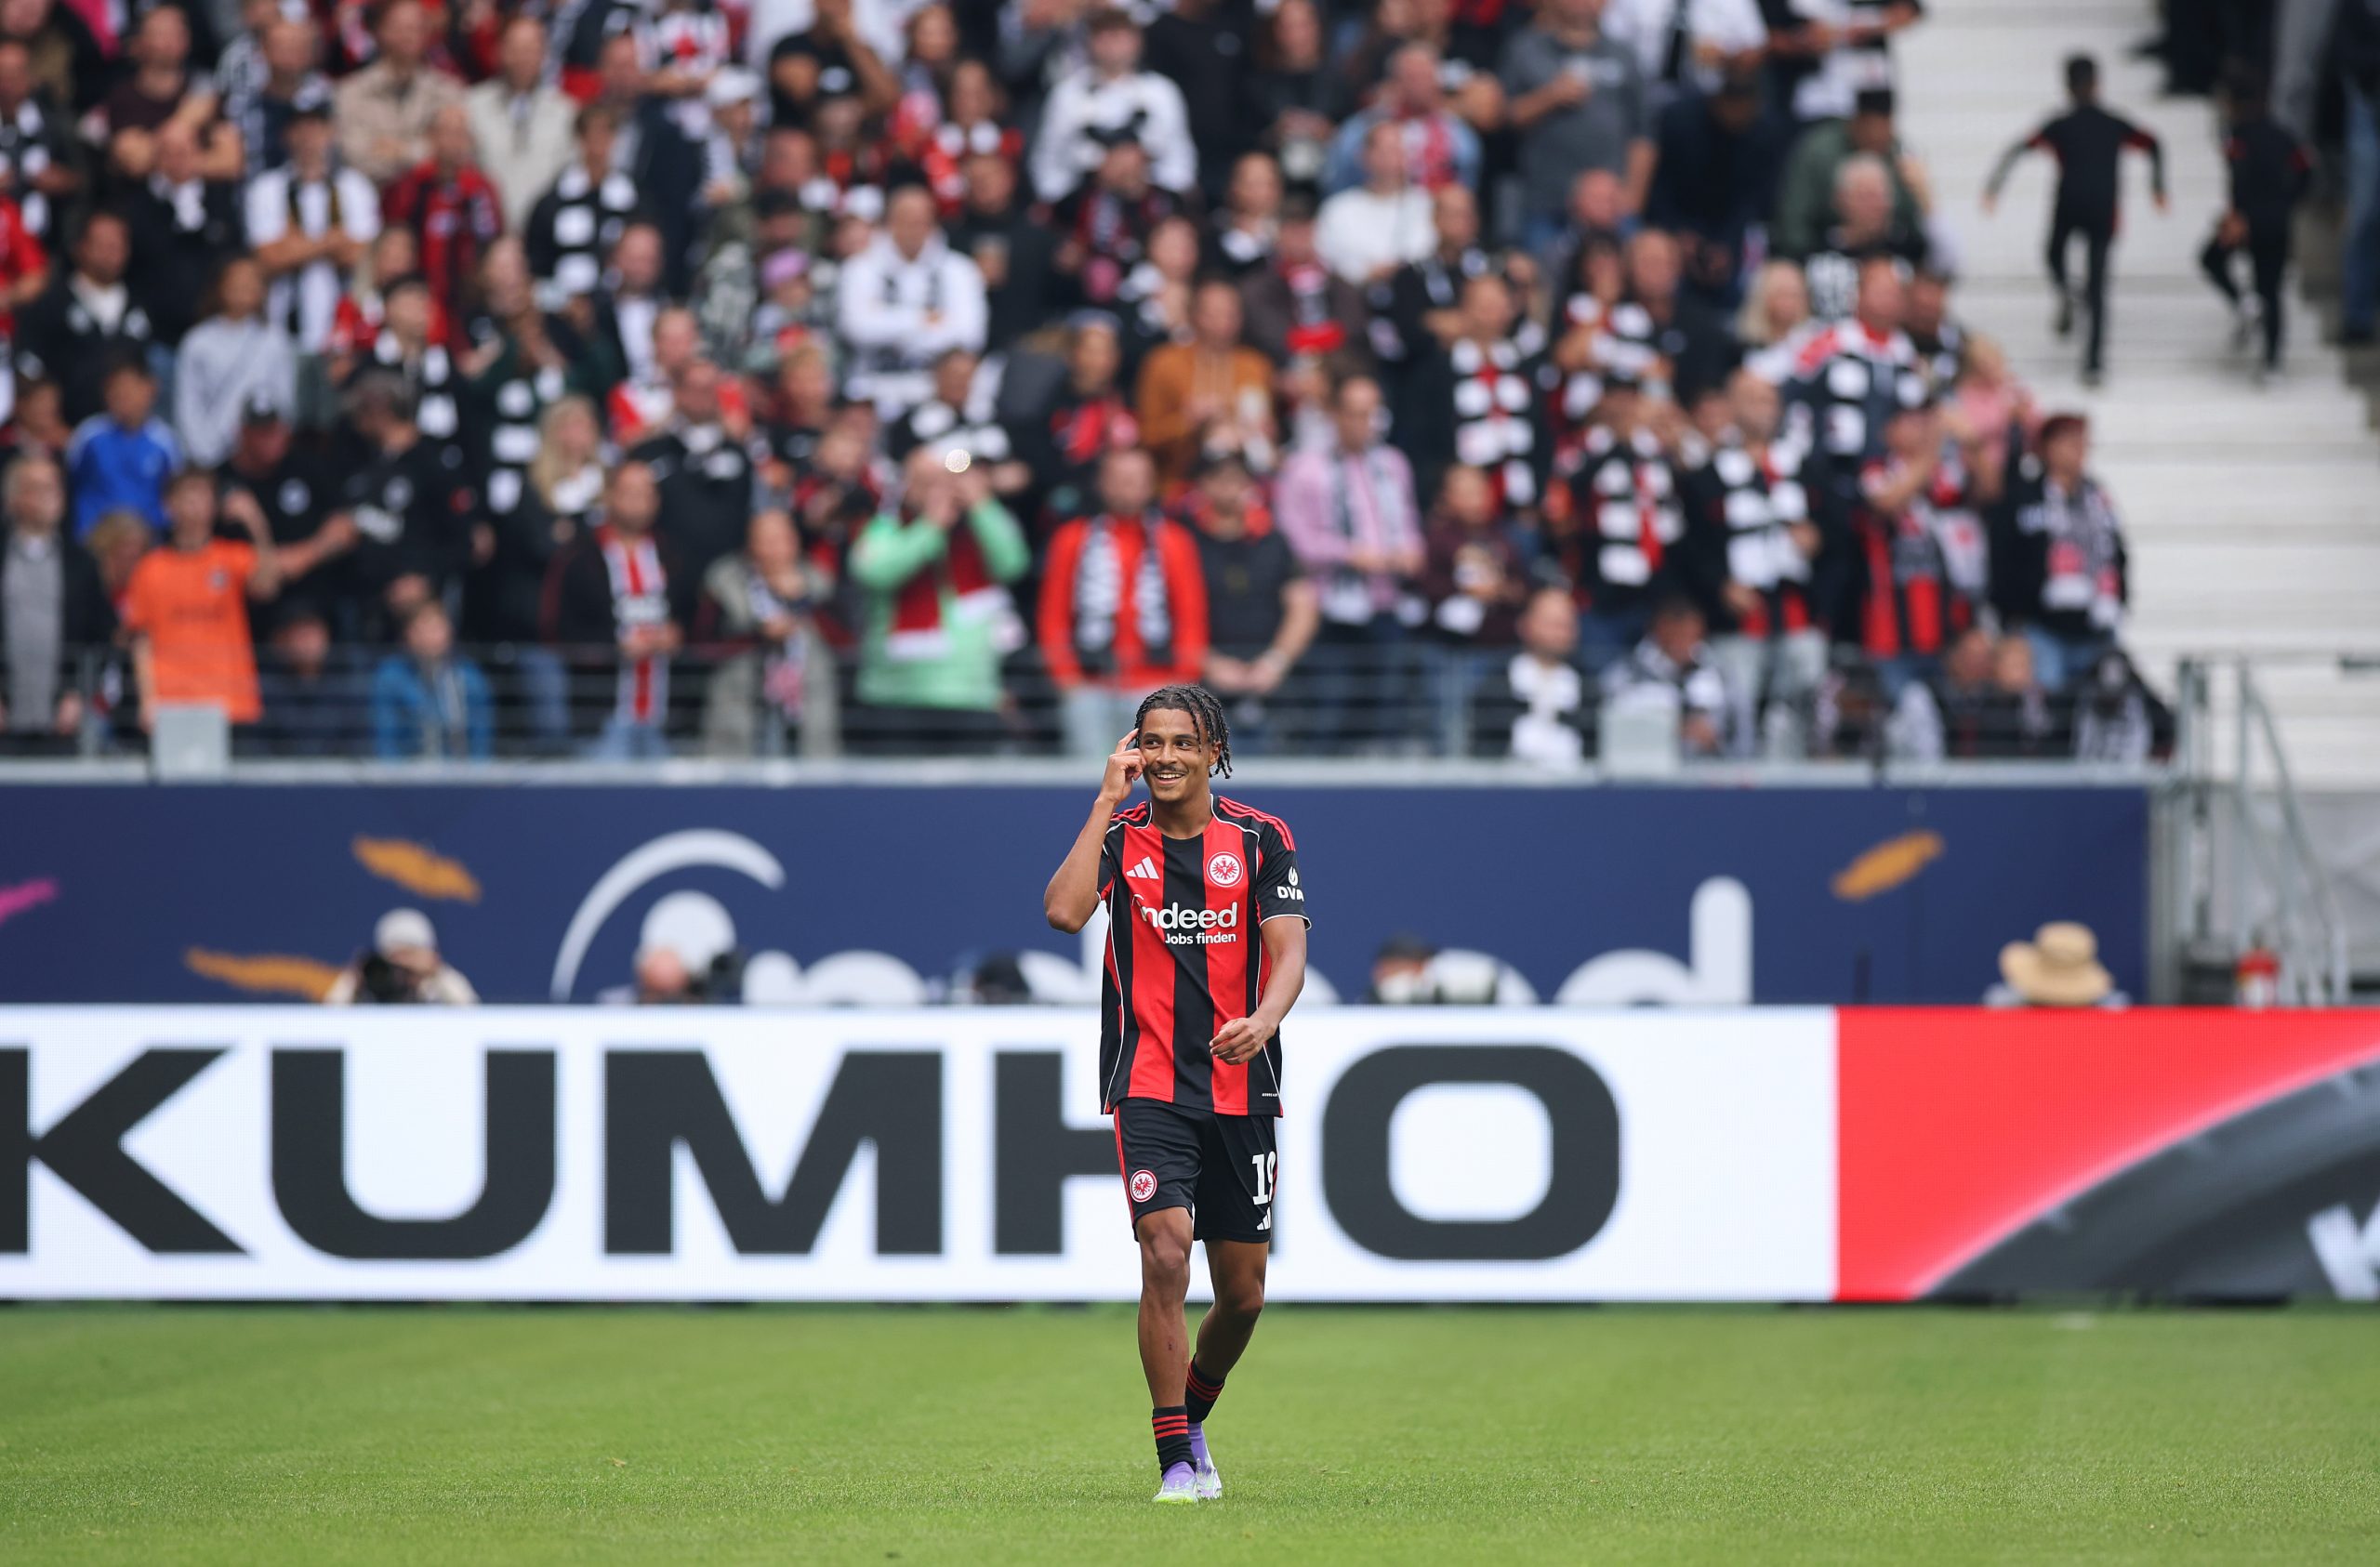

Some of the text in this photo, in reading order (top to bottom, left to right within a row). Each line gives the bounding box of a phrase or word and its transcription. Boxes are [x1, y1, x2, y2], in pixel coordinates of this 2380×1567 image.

[1132, 894, 1237, 929] ndeed
[1165, 932, 1236, 945] Jobs finden
